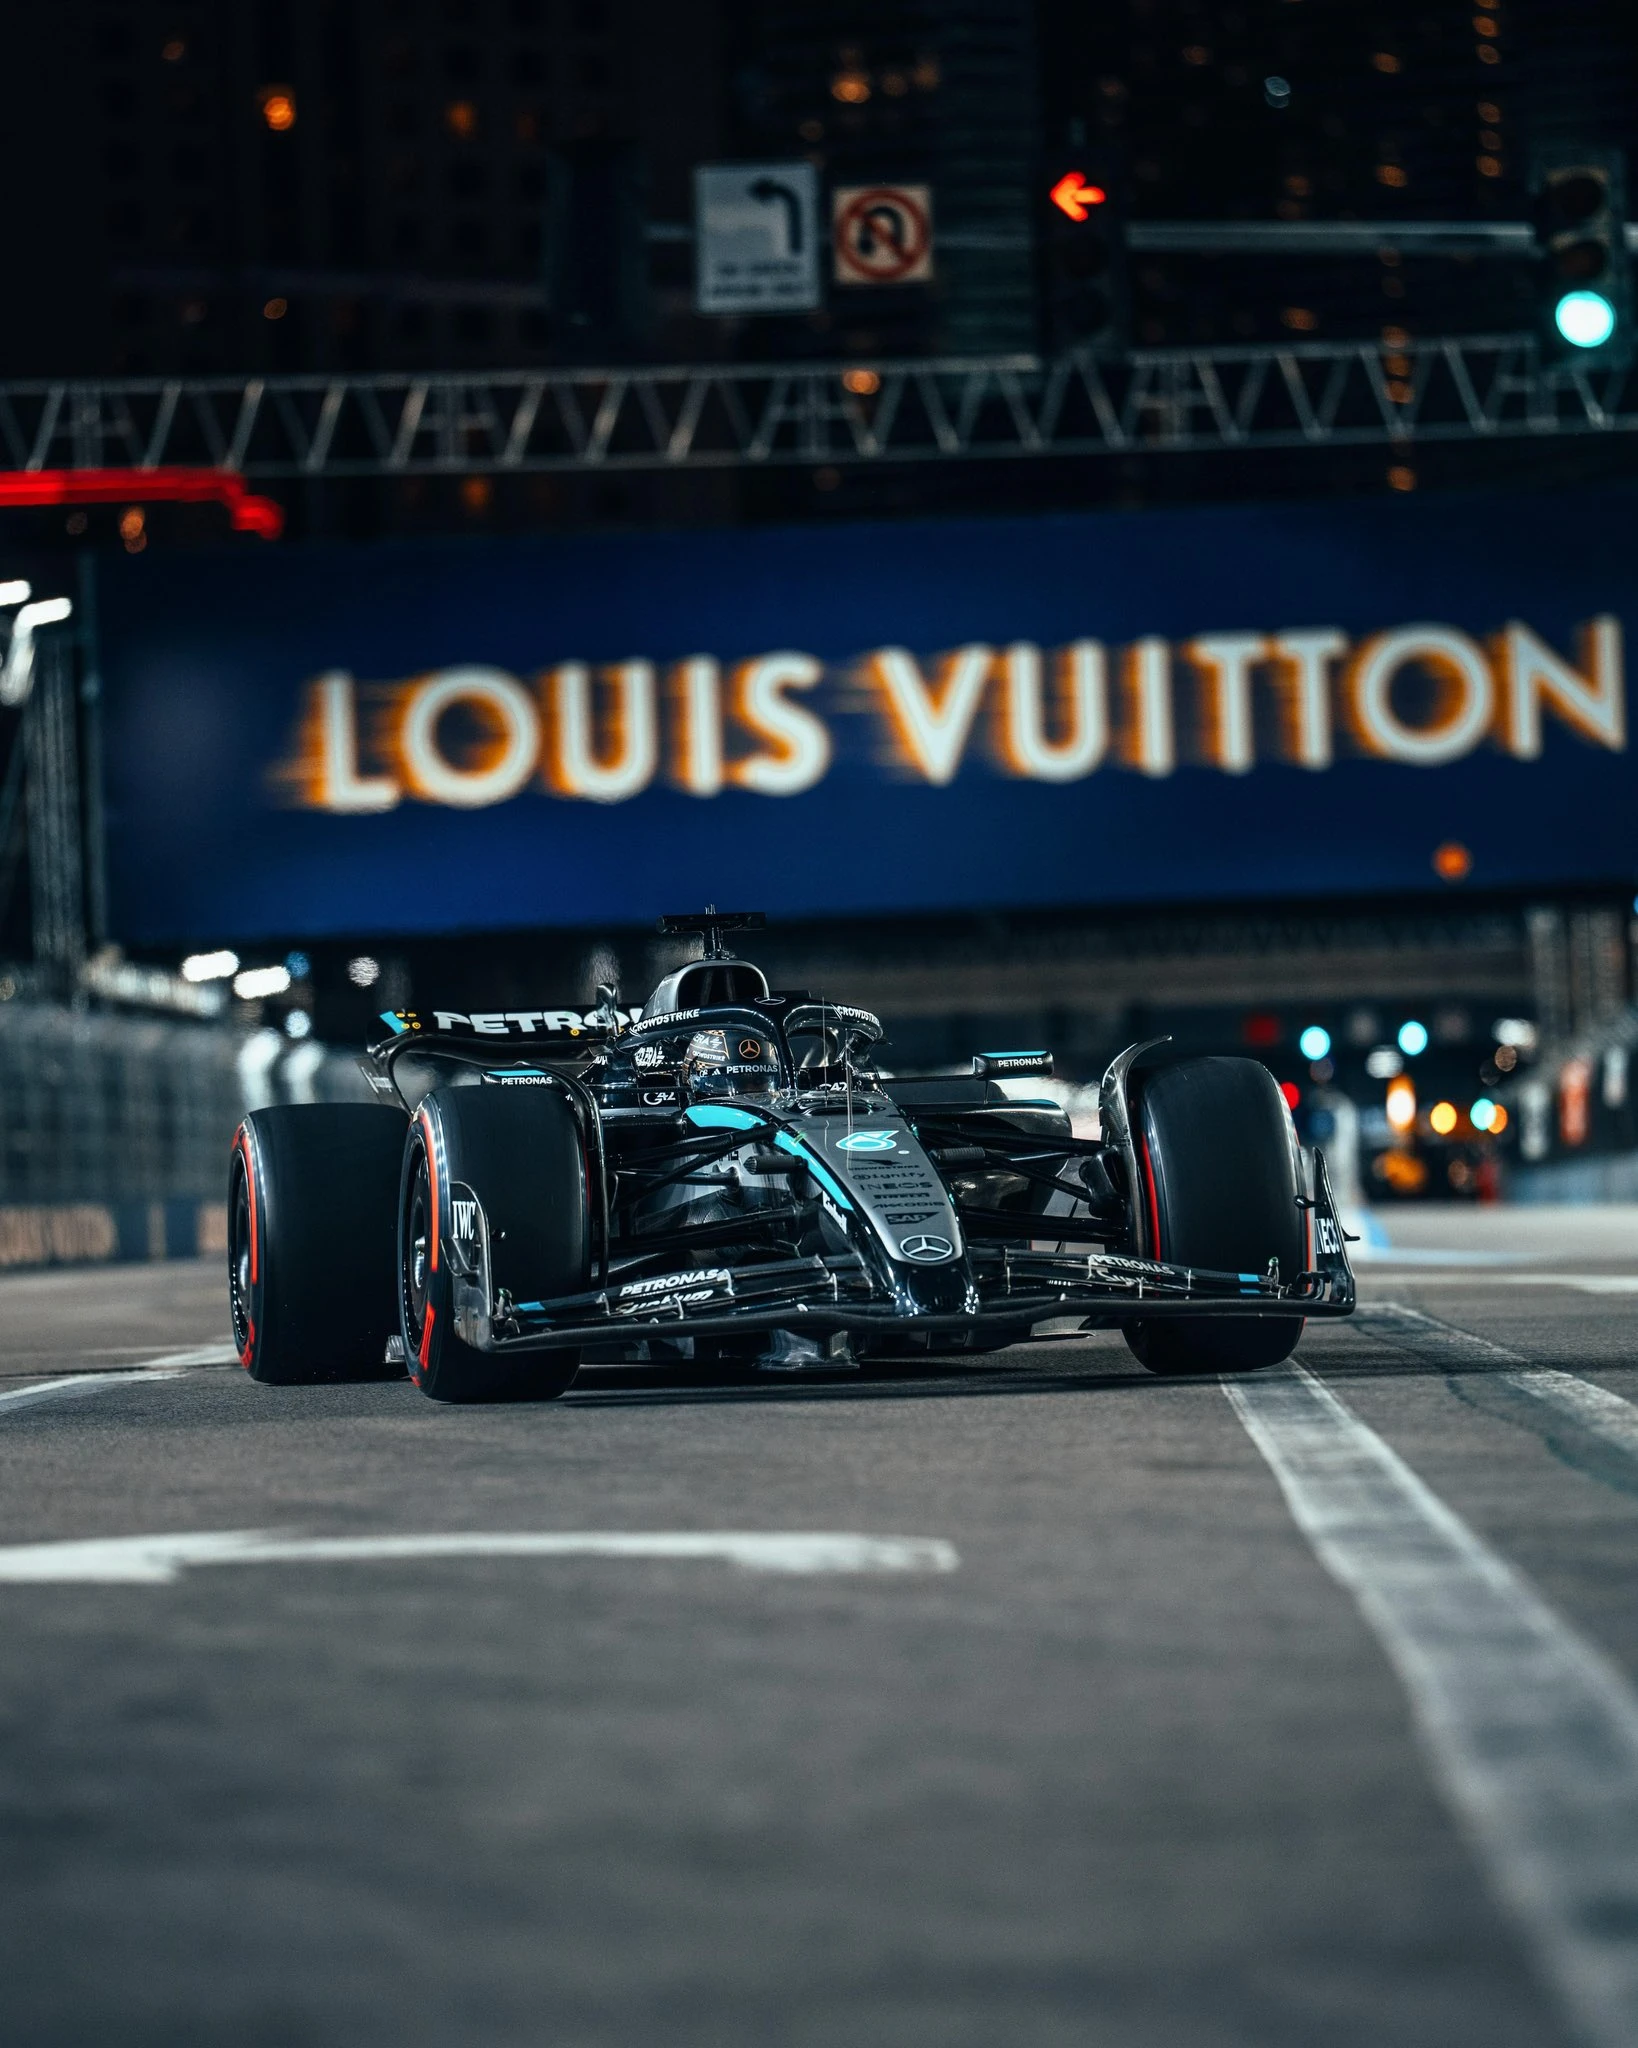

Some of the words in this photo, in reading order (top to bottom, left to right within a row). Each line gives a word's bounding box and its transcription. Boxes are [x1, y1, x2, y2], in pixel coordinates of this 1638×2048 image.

[306, 650, 832, 815] LOUIS
[872, 612, 1626, 786] VUITTON
[633, 1008, 700, 1033] CROWDSTRIKE
[726, 1064, 778, 1075] PETRONAS
[998, 1057, 1043, 1068] PETRONAS
[501, 1076, 553, 1086] PETRONAS
[860, 1181, 933, 1191] INEOS
[452, 1200, 477, 1240] IWC
[888, 1213, 928, 1224] SAP
[1095, 1254, 1176, 1275] PETRONAS
[619, 1268, 719, 1297] PETRONAS
